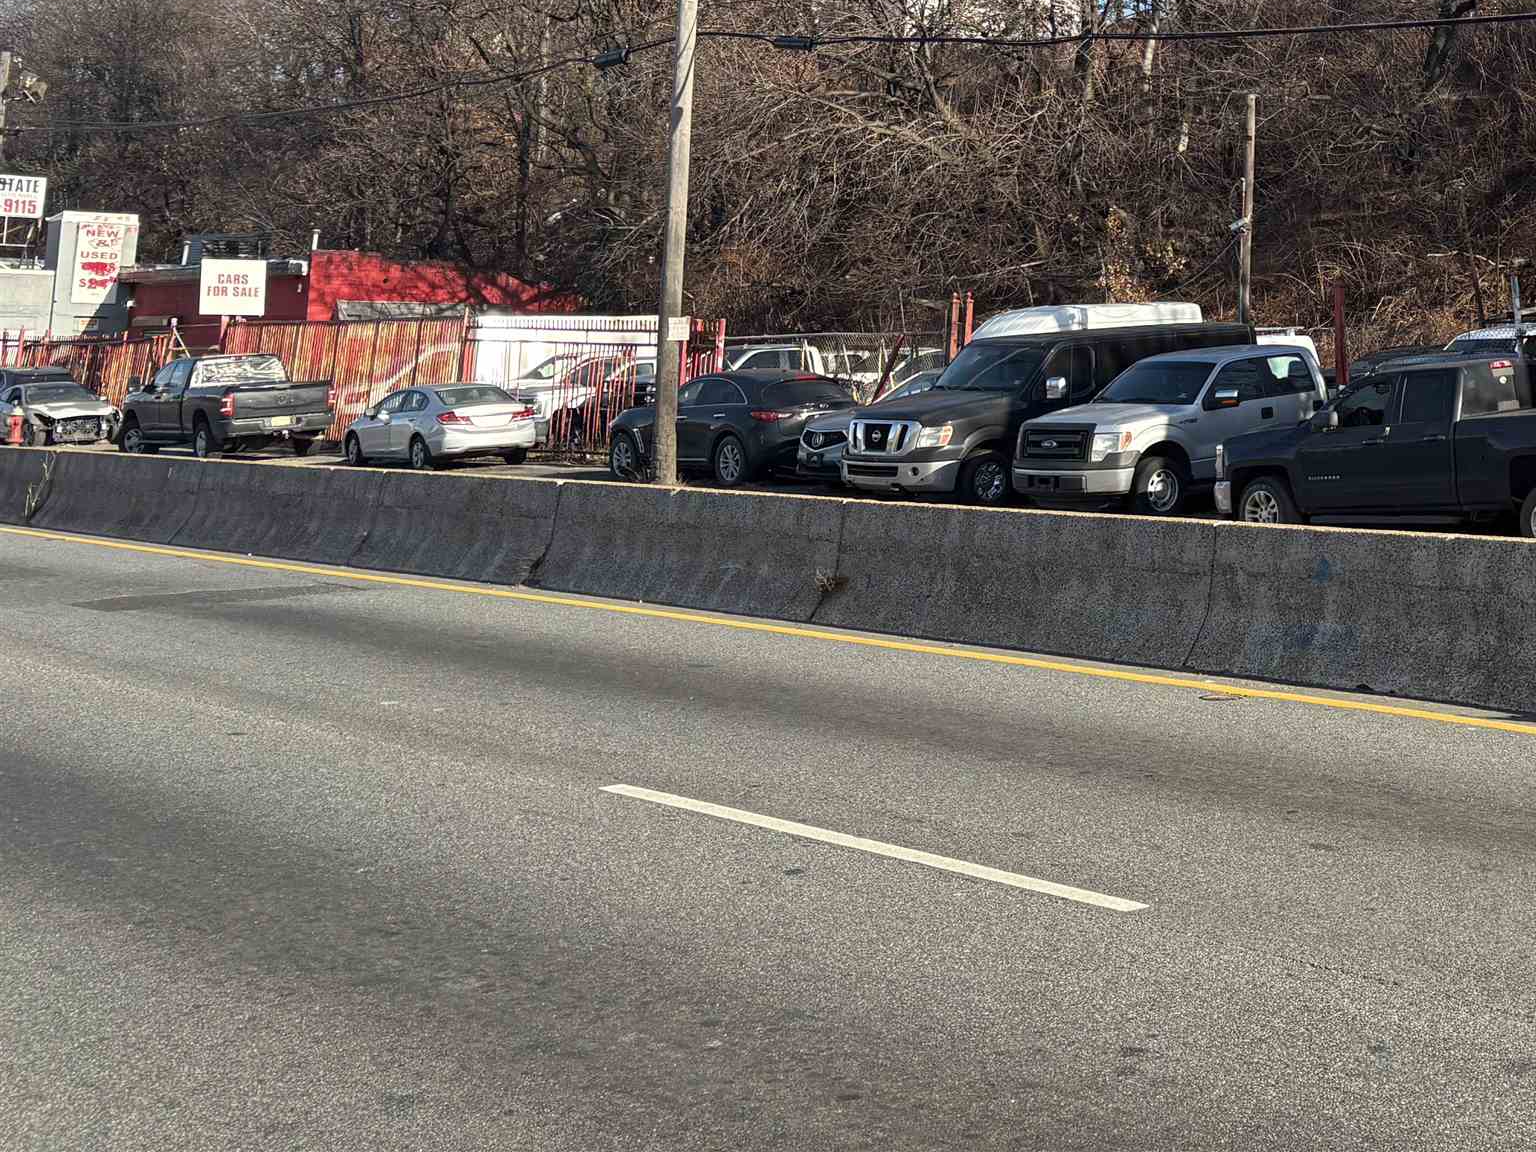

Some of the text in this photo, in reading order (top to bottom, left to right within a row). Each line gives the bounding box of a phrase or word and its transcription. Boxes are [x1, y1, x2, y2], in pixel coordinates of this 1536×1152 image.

[86, 229, 119, 238] NEW
[80, 251, 118, 260] USED
[217, 273, 249, 285] CARS
[207, 286, 261, 297] FOR SALE
